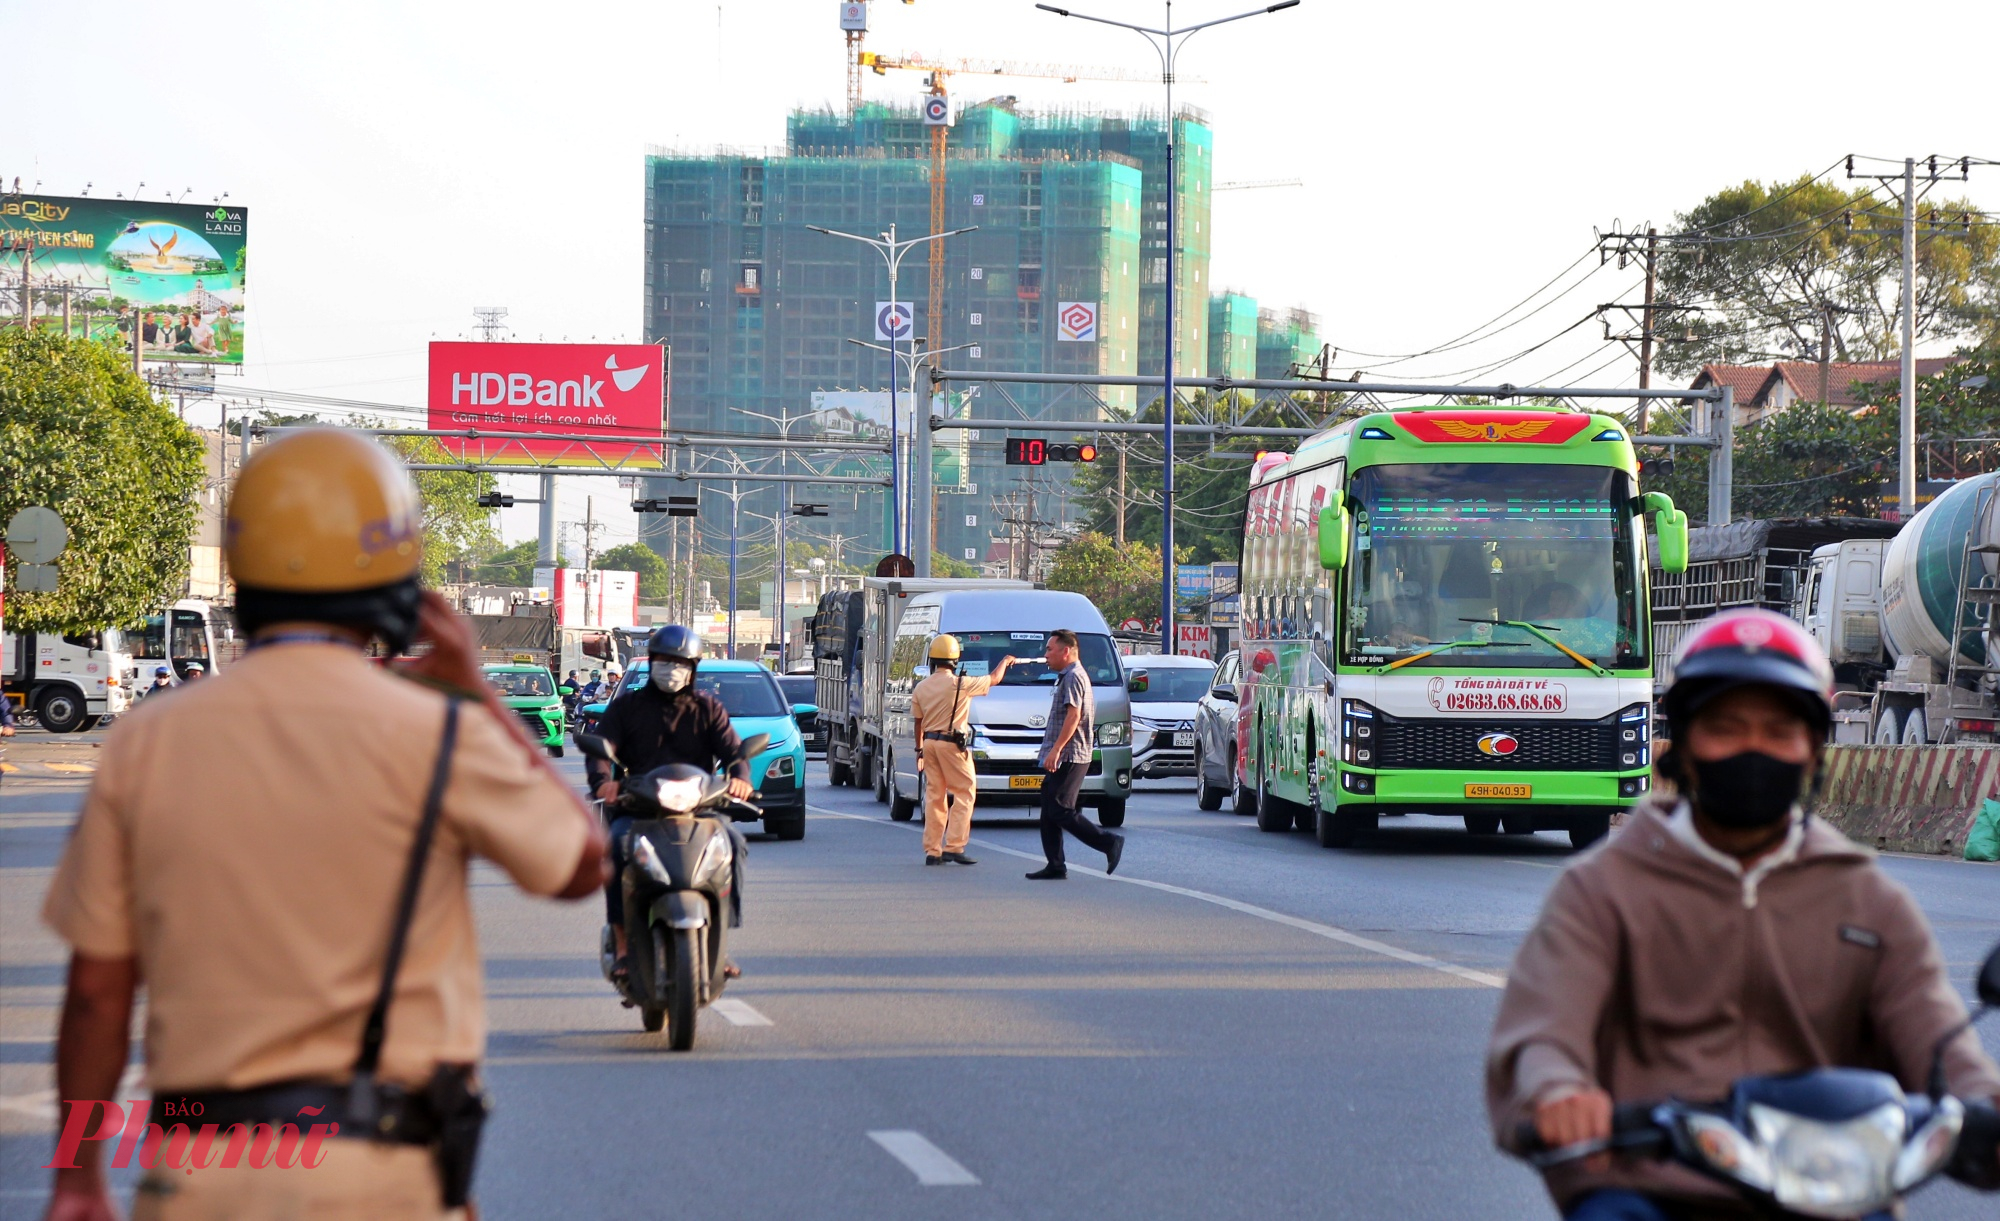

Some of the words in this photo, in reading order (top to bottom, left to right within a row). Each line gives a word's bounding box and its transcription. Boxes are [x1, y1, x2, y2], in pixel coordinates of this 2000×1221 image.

[973, 195, 983, 204] 22
[205, 223, 242, 232] LAND
[972, 269, 981, 278] 20
[972, 314, 980, 324] 18
[971, 348, 980, 357] 16
[452, 372, 604, 408] HDBank
[587, 413, 618, 426] nhất
[970, 431, 979, 440] 12
[1020, 440, 1043, 465] 10
[1180, 626, 1209, 641] KIM
[1454, 677, 1484, 689] TỔNG
[1486, 678, 1507, 689] ĐÀI
[1508, 679, 1533, 691] ĐẶT
[1535, 679, 1549, 690] VÉ
[1446, 693, 1562, 710] 02633.68.68.68
[1470, 786, 1526, 796] 49H-040.93
